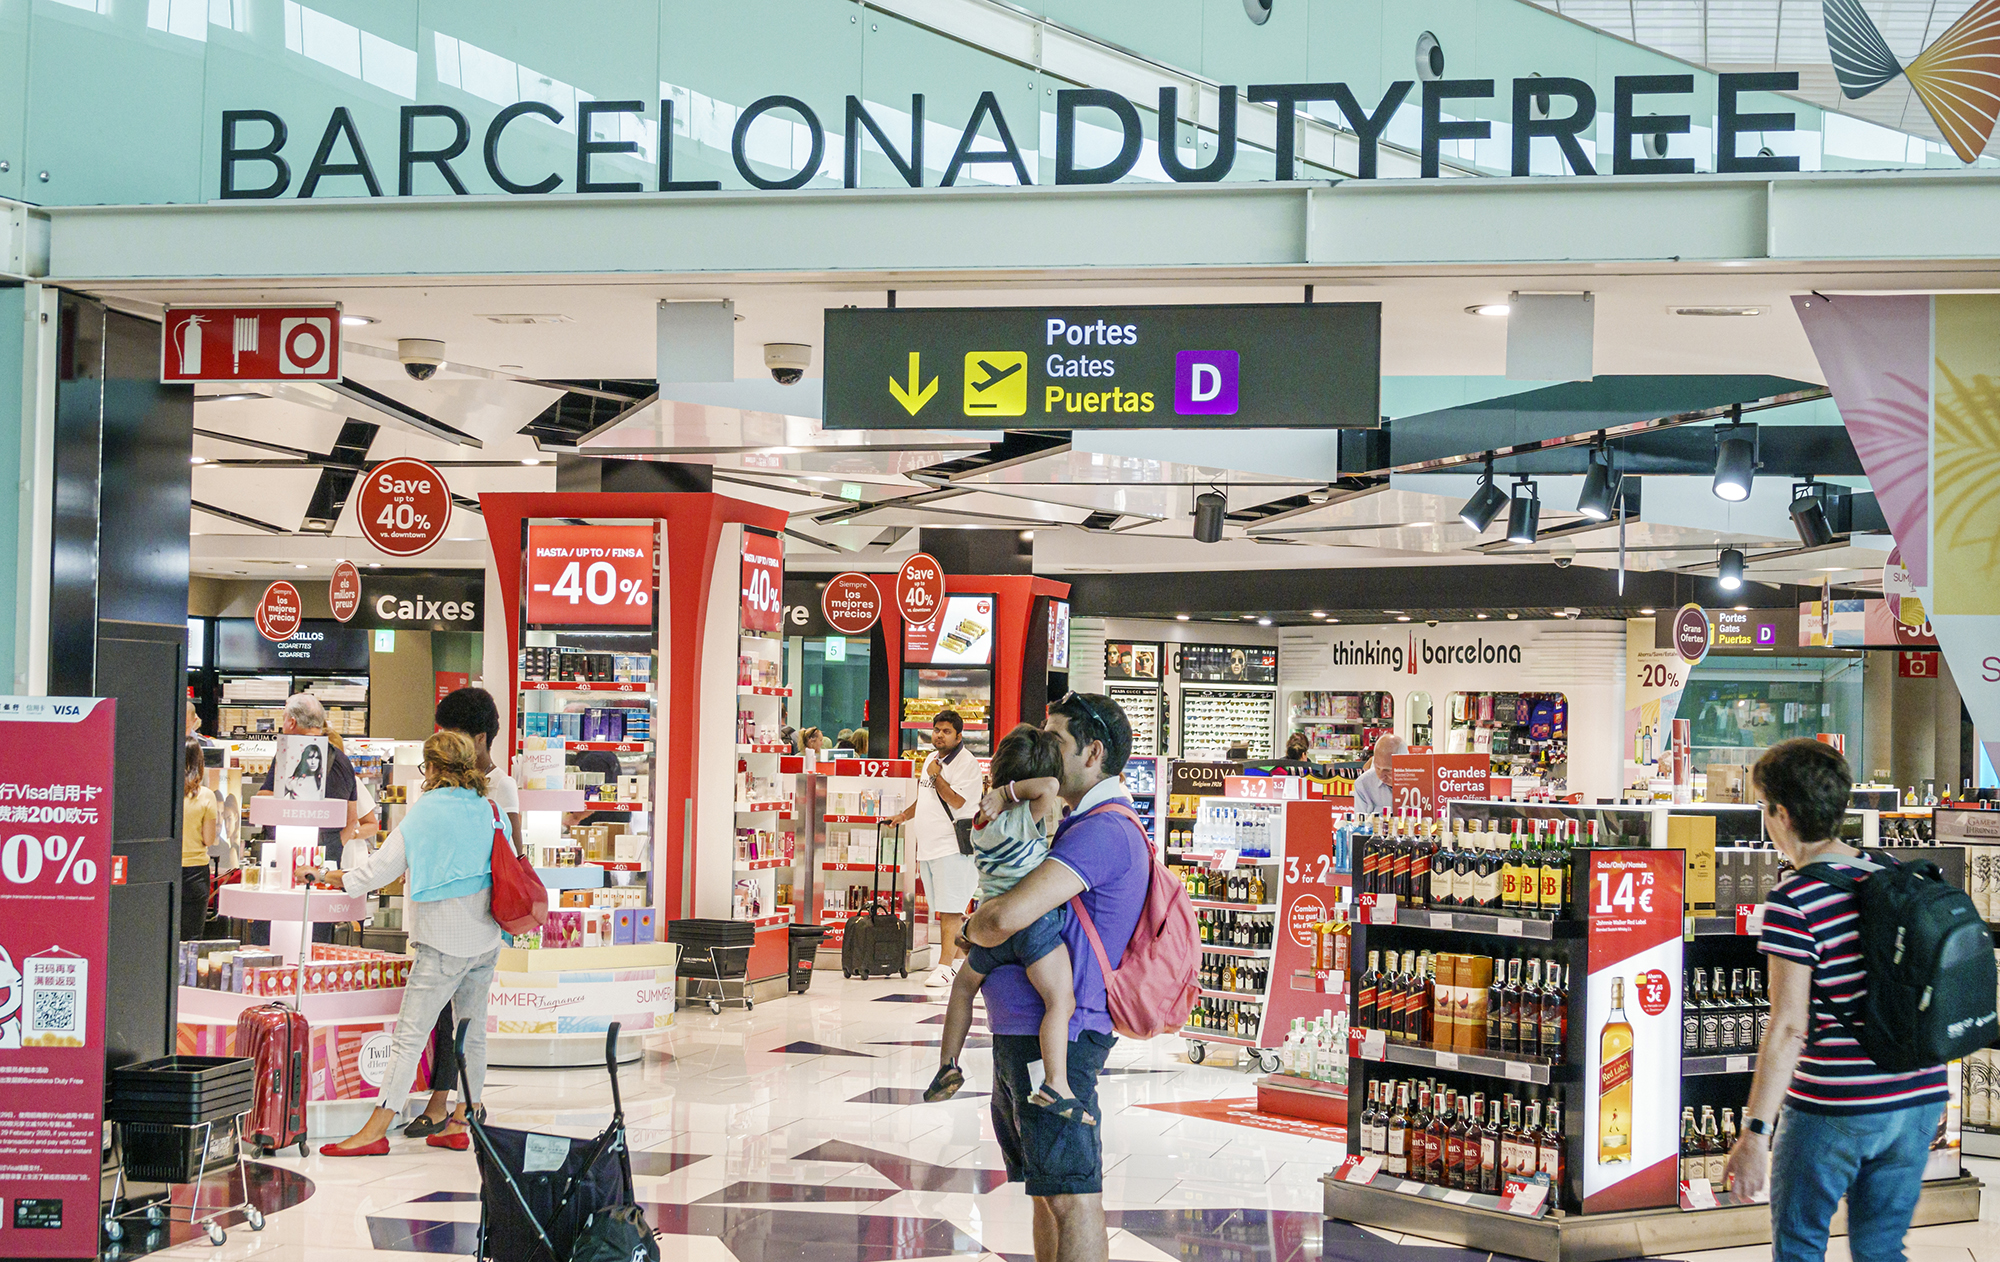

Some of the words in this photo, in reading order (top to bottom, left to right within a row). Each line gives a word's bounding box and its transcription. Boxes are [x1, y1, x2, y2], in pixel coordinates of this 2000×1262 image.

[1046, 318, 1138, 346] Portes
[1046, 353, 1115, 378] Gates
[1191, 363, 1222, 402] D
[1045, 385, 1155, 413] Puertas
[378, 474, 431, 494] Save
[376, 504, 431, 530] 40%
[537, 548, 568, 557] HASTA
[576, 548, 590, 557] UP
[591, 548, 604, 557] TO
[612, 548, 635, 557] FINS
[906, 566, 934, 580] Save
[340, 578, 349, 588] els
[534, 561, 648, 605] -40%
[839, 581, 867, 589] Siempre
[334, 589, 355, 599] millors
[742, 568, 780, 613] -40%
[845, 589, 861, 599] los
[277, 595, 288, 604] los
[905, 587, 933, 606] 40%
[268, 605, 296, 614] mejores
[335, 601, 353, 611] preus
[376, 594, 475, 620] Caixes
[831, 599, 874, 610] mejores
[269, 614, 295, 623] precios
[832, 609, 872, 620] precios
[1719, 613, 1747, 623] Portes
[1683, 624, 1701, 633] Grans
[1719, 624, 1740, 633] Gates
[1760, 627, 1771, 641] D
[290, 632, 324, 640] RILLOS
[1680, 633, 1704, 643] Ofertes
[1718, 634, 1751, 644] Puertas
[380, 638, 385, 647] 1
[831, 646, 837, 655] 5
[1333, 640, 1403, 672] thinking
[1422, 638, 1521, 664] barcelona
[1637, 664, 1679, 687] -20%
[53, 705, 80, 715] VISA
[1177, 767, 1237, 779] GODIVA
[1437, 766, 1486, 779] Grandes
[1241, 779, 1249, 797] 3
[1258, 779, 1267, 797] 2
[1440, 780, 1485, 792] Ofertas
[1395, 787, 1432, 810] -20%
[1968, 816, 1990, 826] GAME
[1966, 826, 1999, 834] THRONES
[0, 834, 97, 884] 0%
[1285, 856, 1299, 884] 3
[1305, 863, 1311, 872] x
[1317, 854, 1330, 883] 2
[1302, 874, 1314, 883] for
[329, 904, 350, 913] NEW
[636, 986, 672, 1004] SUMMER
[537, 995, 585, 1013] Fragrances
[367, 1045, 391, 1059] Twill
[1602, 1069, 1613, 1082] Red
[1613, 1061, 1630, 1077] Label
[54, 1077, 68, 1085] Duty
